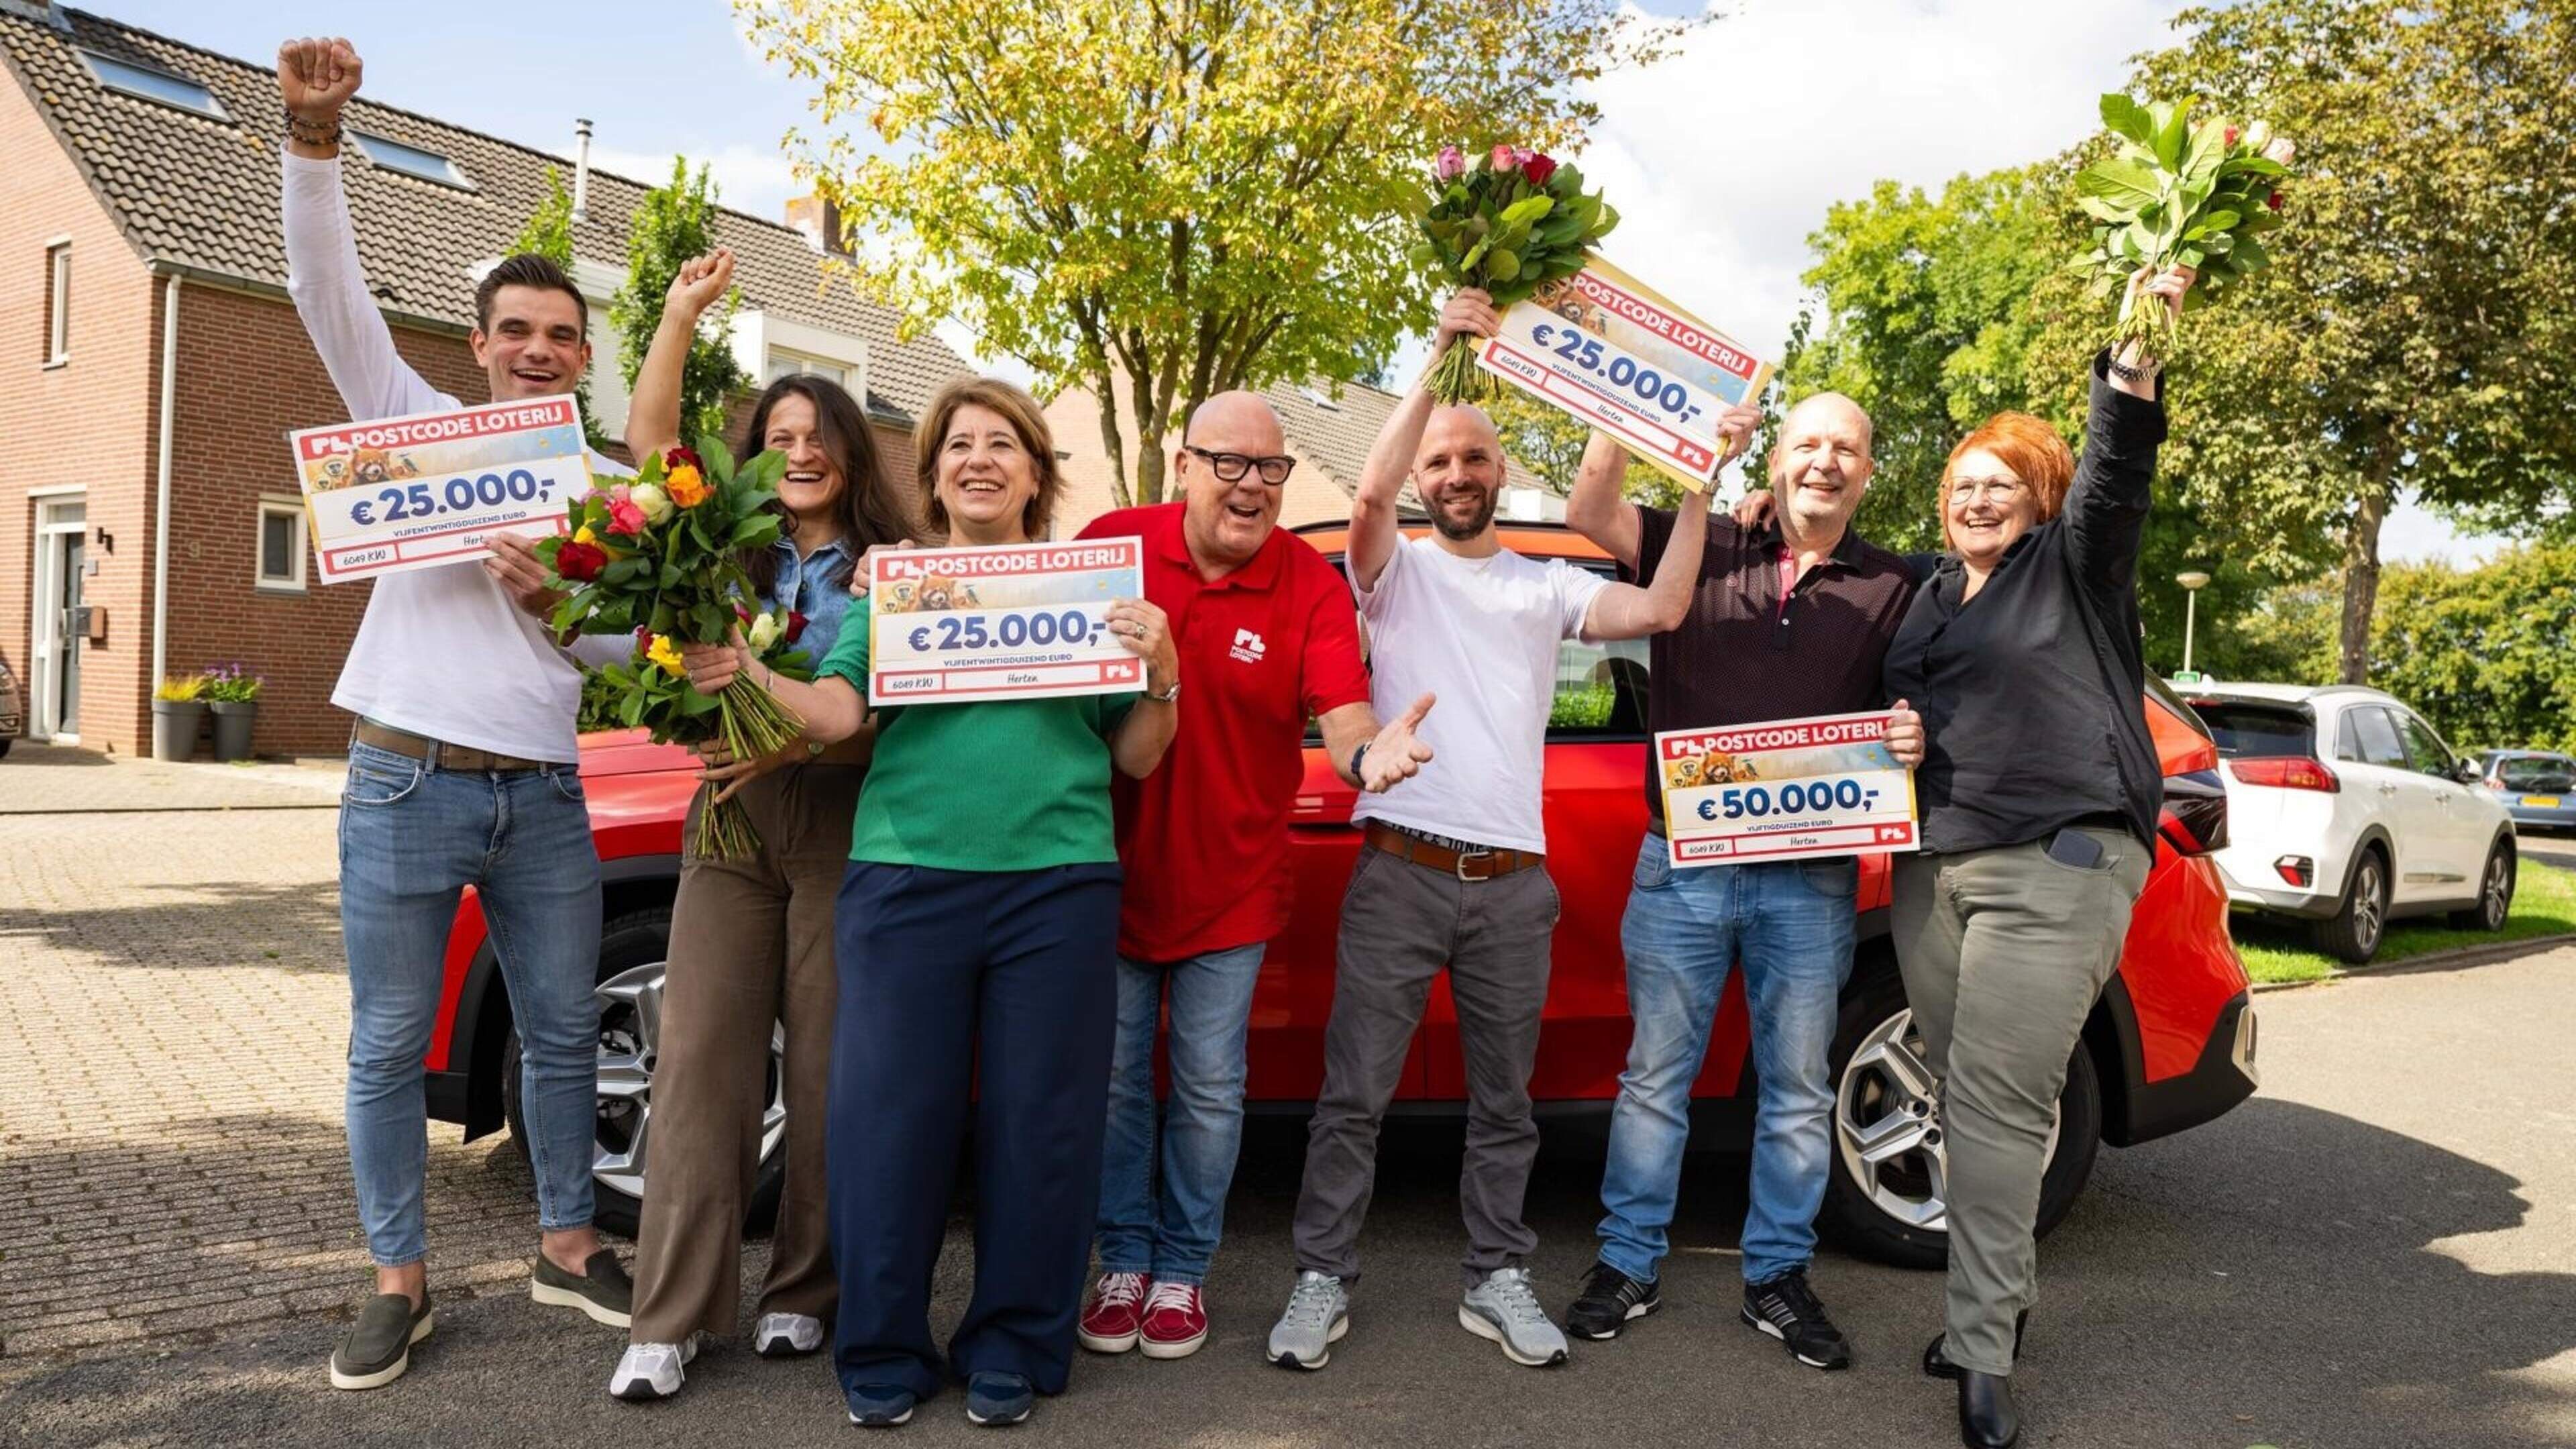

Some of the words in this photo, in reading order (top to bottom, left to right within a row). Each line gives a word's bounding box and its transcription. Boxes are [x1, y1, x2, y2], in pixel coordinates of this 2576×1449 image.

[1574, 274, 1673, 332] POSTCODE
[1672, 326, 1748, 372] LOTERIJ
[1552, 363, 1640, 414] VIJFENTWINTIGDUIZEND
[1640, 408, 1662, 424] EURO
[1597, 405, 1624, 424] Herten
[351, 417, 473, 447] POSTCODE
[475, 405, 563, 431] LOTERIJ
[393, 515, 500, 537] VIJFENTWINTIGDUIZEND
[502, 511, 527, 521] EURO
[464, 535, 484, 546] Hert
[343, 554, 366, 565] 6049
[368, 550, 386, 561] KW
[924, 553, 1037, 575] POSTCODE
[1042, 547, 1126, 568] LOTERIJ
[944, 655, 1047, 667] VIJFENTWINTIGDUIZEND
[1049, 653, 1072, 661] EURO
[892, 680, 913, 689] 6049
[916, 678, 933, 688] KW
[1007, 674, 1038, 684] Herten
[1705, 728, 1810, 752] POSTCODE
[1813, 721, 1886, 742] LOTERI
[1747, 821, 1809, 832] VIJFTIGDUIZEND
[1689, 845, 1707, 854] 6049
[1709, 843, 1725, 853] KW
[1790, 837, 1819, 846] Herten
